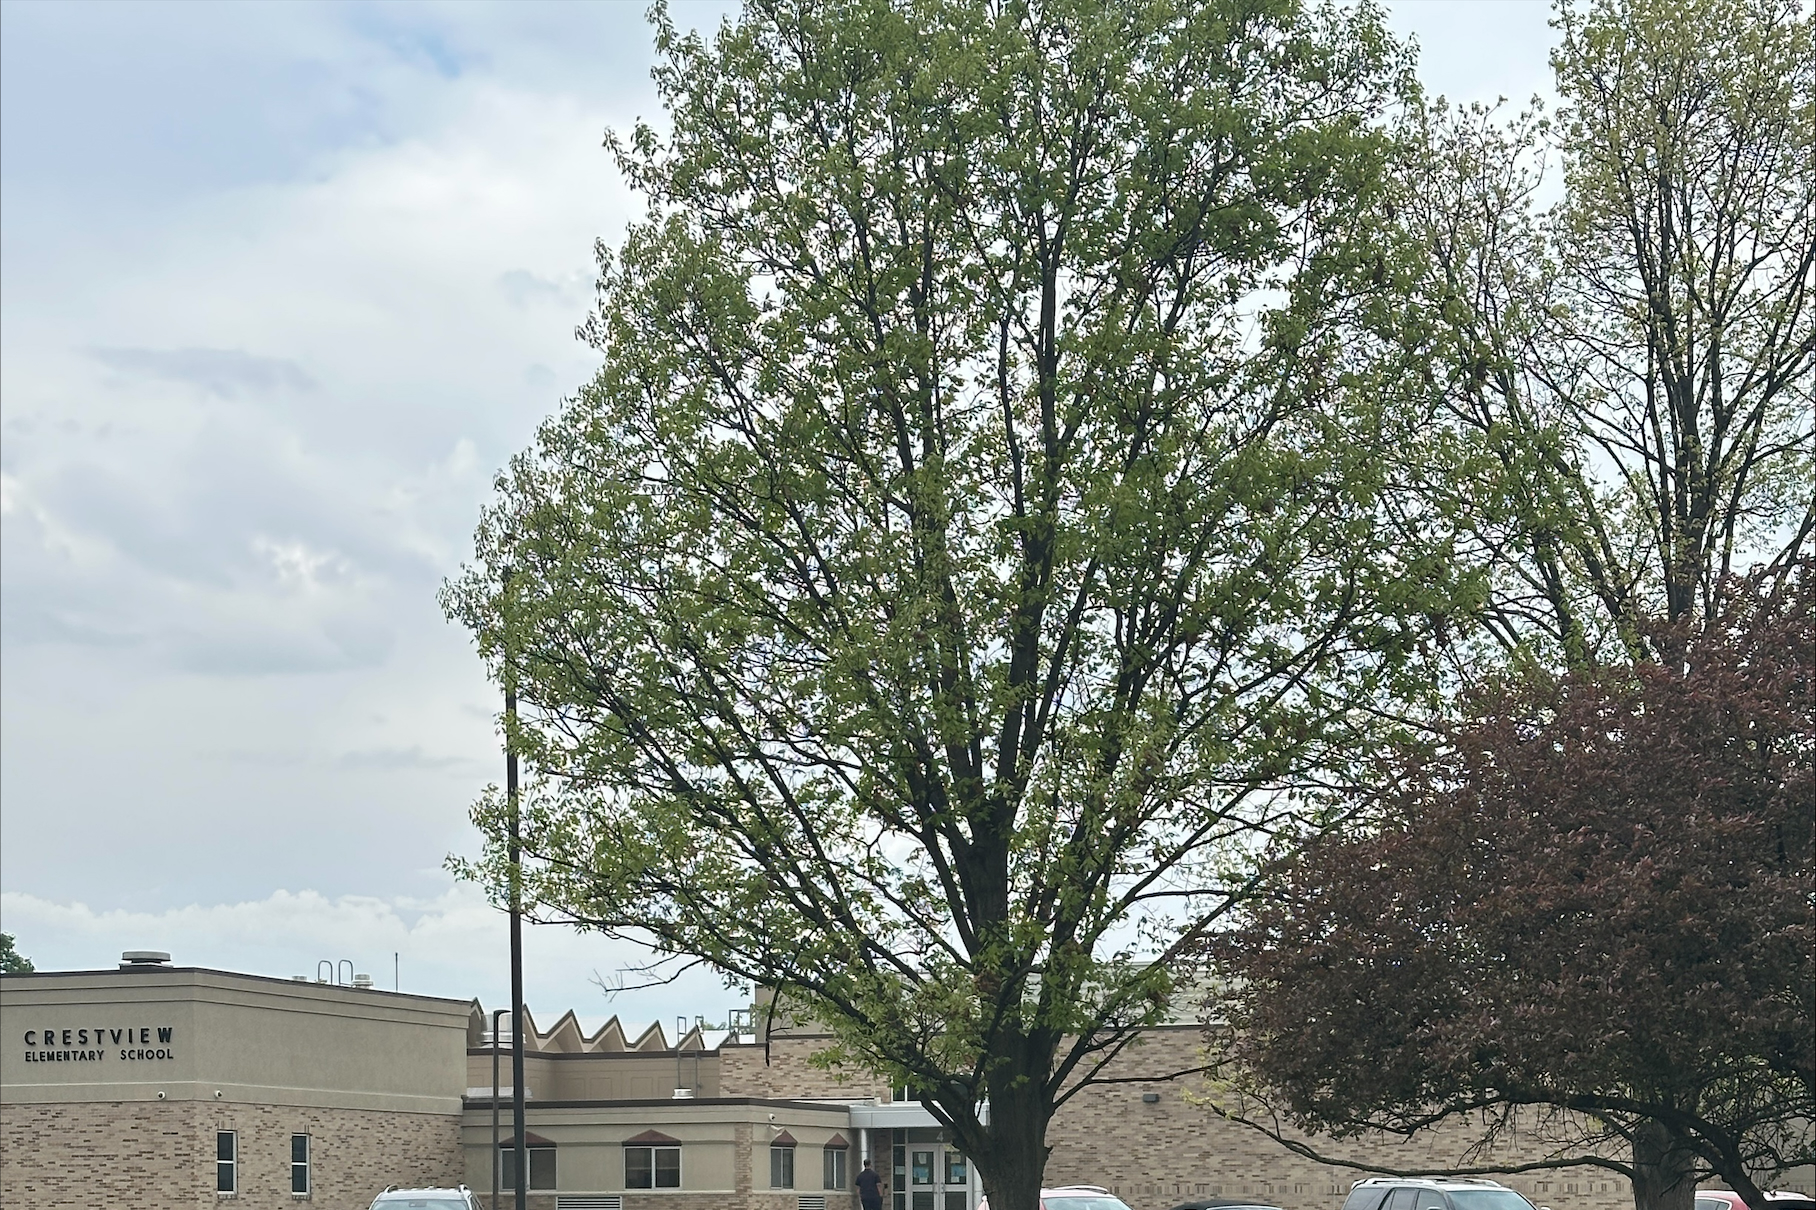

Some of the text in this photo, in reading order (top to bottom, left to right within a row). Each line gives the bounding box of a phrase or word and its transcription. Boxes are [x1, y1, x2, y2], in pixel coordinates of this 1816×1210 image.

[24, 1027, 173, 1046] CRESTVIEW
[25, 1049, 174, 1062] ELEMENTARY SCHOOL
